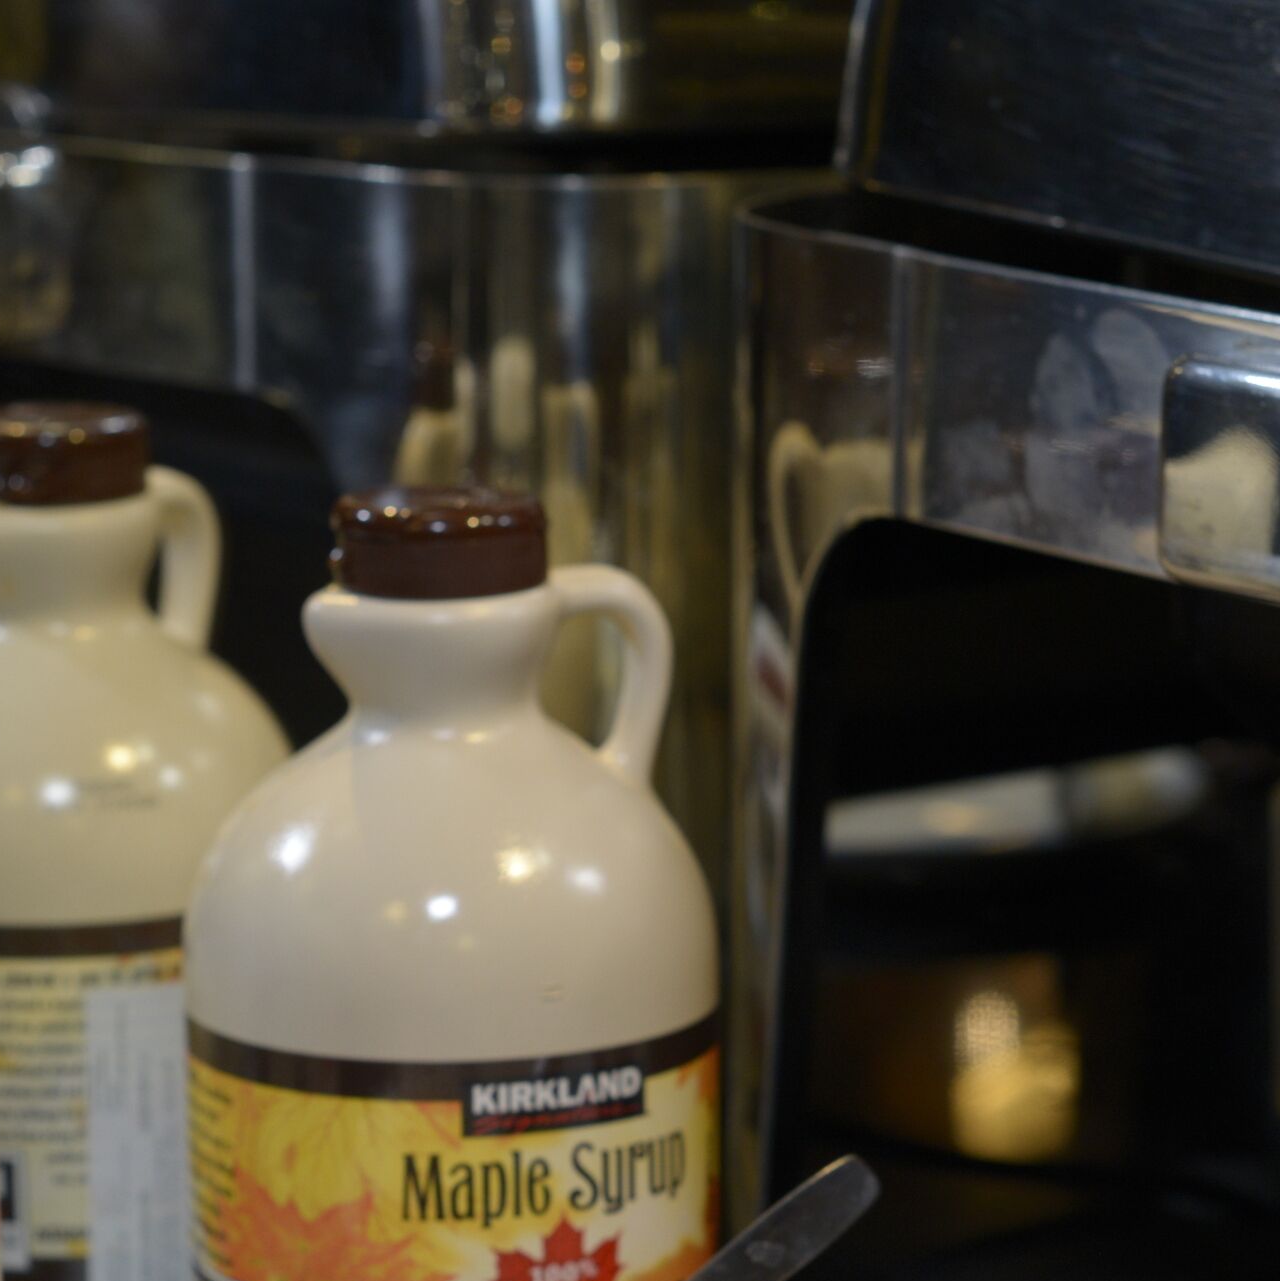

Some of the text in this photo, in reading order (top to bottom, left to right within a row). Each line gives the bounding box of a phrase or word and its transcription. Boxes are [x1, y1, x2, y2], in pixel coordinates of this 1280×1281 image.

[472, 1065, 642, 1115] KIRKLAND
[403, 1131, 685, 1228] Maple Syrup
